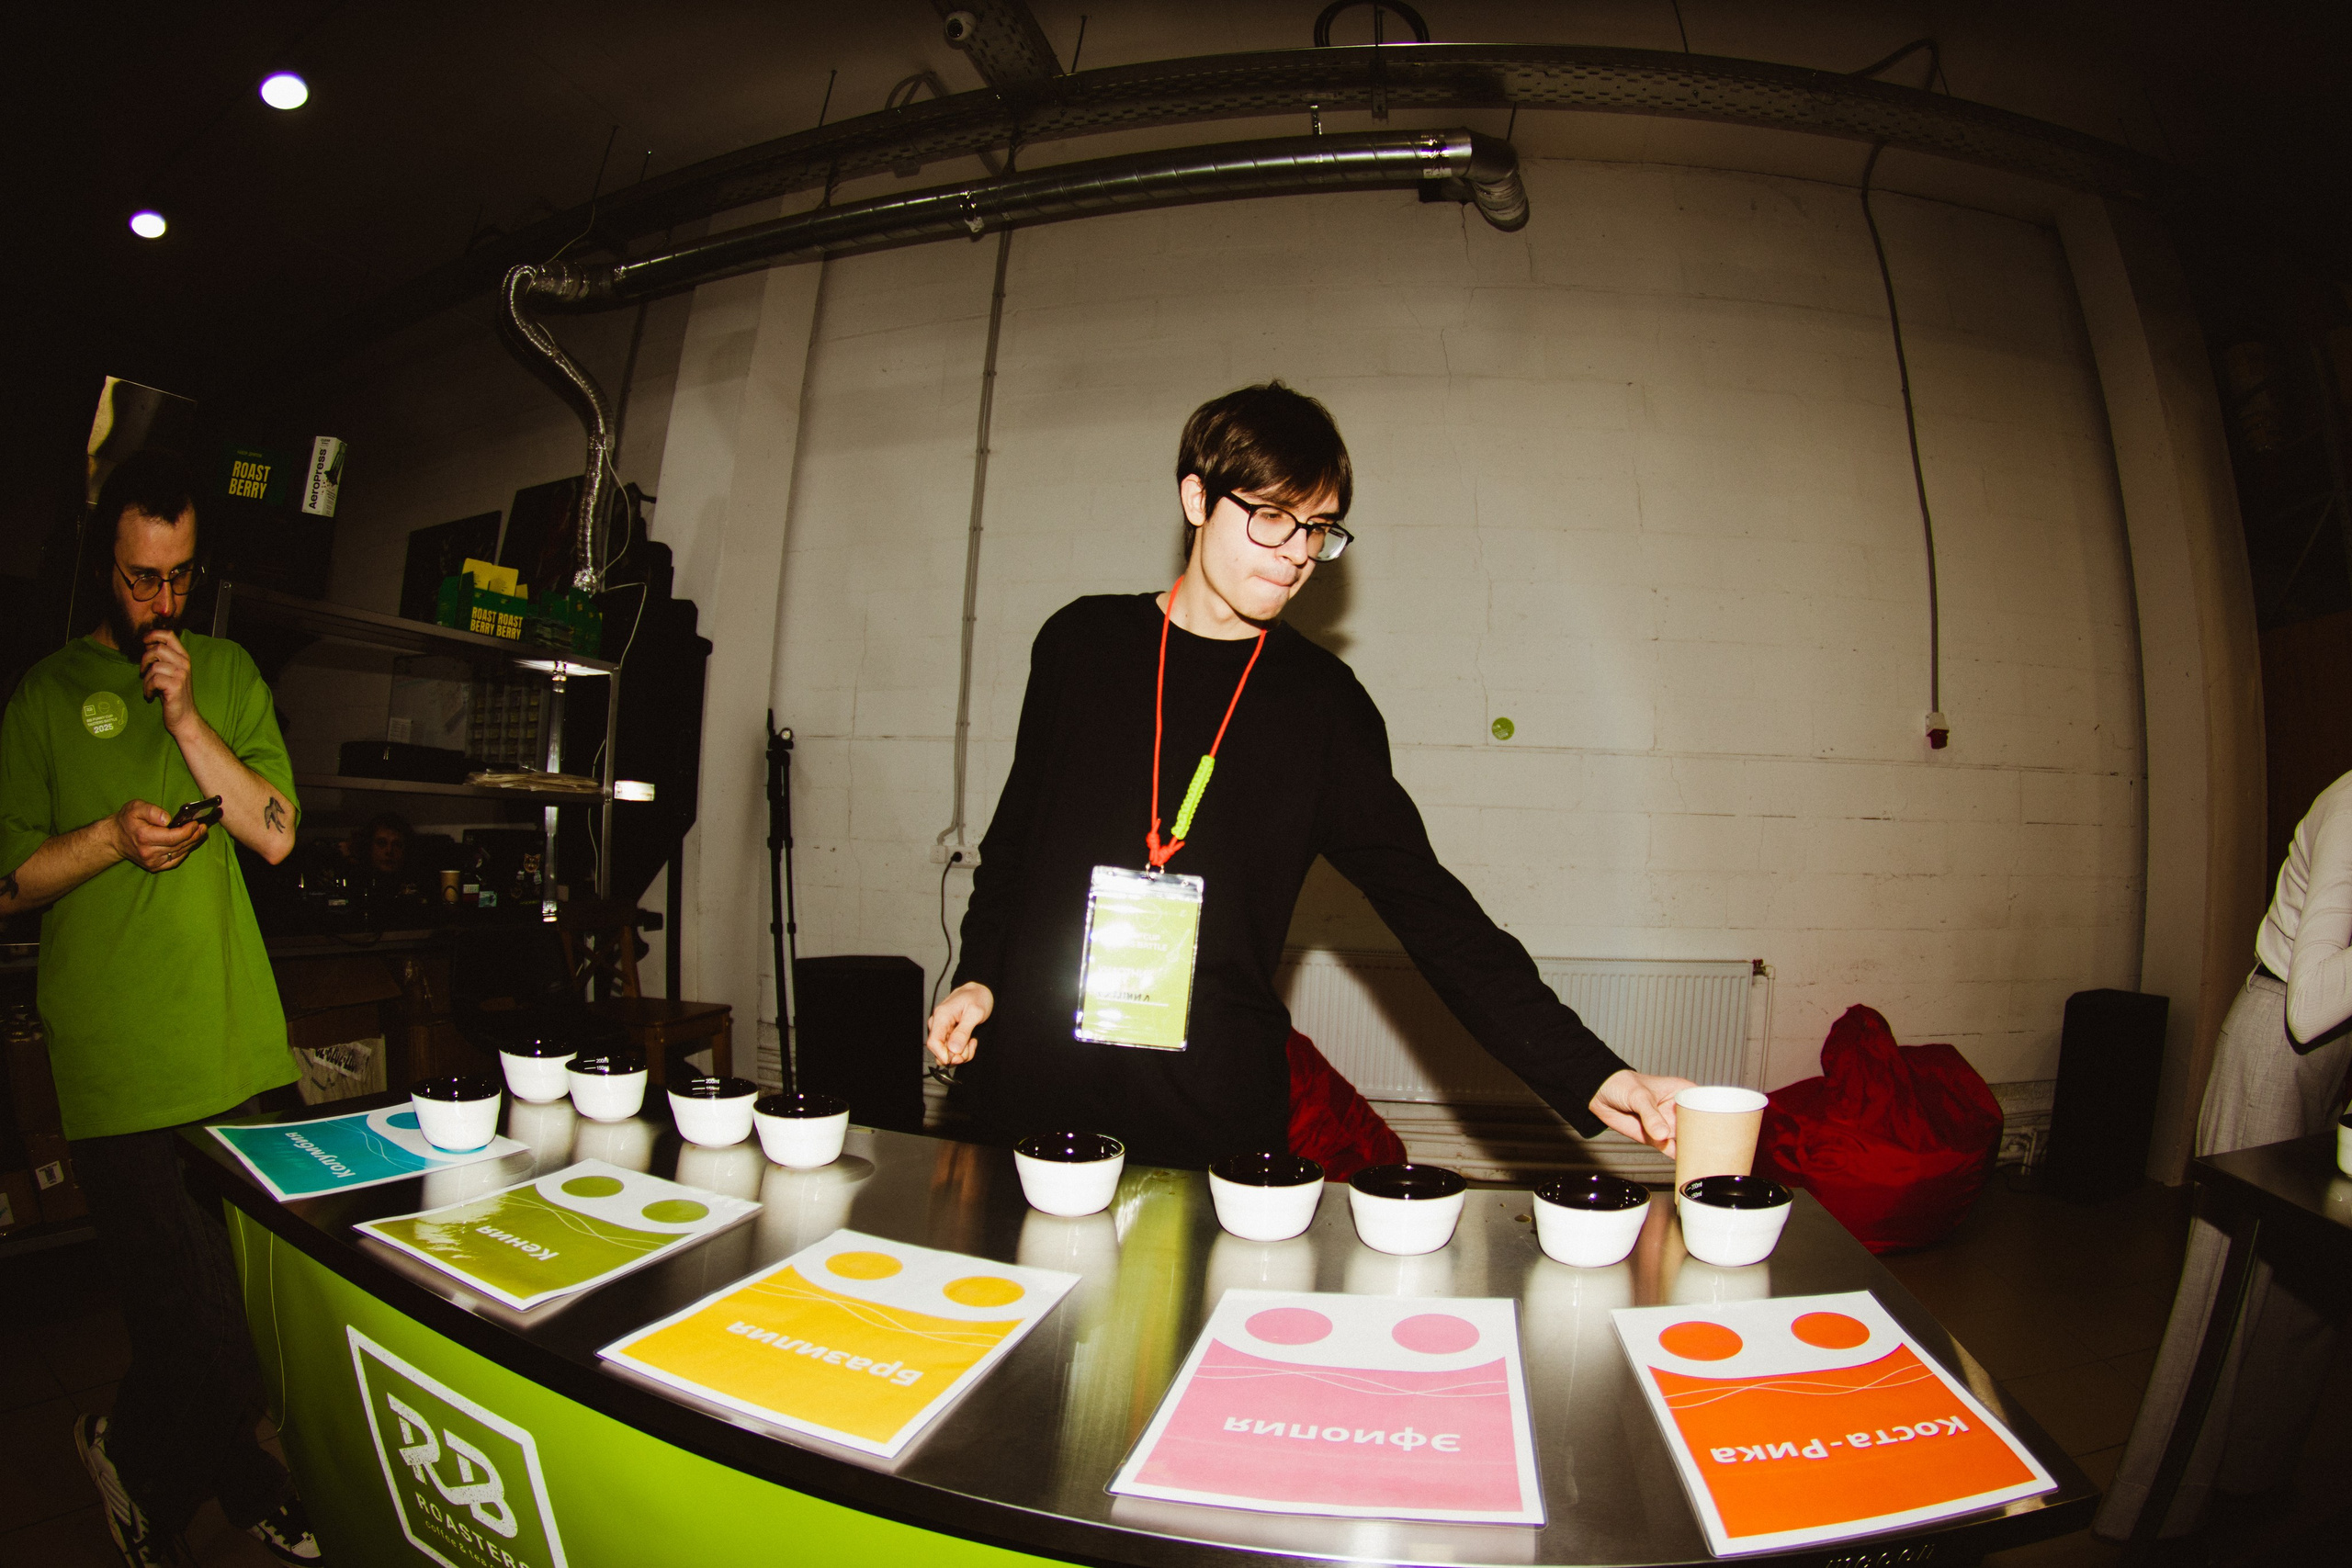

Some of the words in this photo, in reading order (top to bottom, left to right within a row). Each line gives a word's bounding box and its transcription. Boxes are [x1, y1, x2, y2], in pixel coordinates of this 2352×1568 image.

[232, 460, 271, 482] ROAST
[309, 448, 327, 509] AeroPress
[228, 478, 267, 500] BERRY
[472, 606, 498, 623] ROAST
[497, 612, 524, 628] ROAST
[469, 618, 495, 636] BERRY
[496, 625, 522, 641] BERRY
[94, 723, 114, 734] 2025
[1138, 941, 1168, 952] BATTLE
[285, 1132, 356, 1179] Колумбия
[476, 1225, 560, 1261] Кения
[726, 1320, 923, 1387] Бразилия
[1223, 1416, 1462, 1452] Эфиопия
[1711, 1415, 1969, 1464] Коста-Рика
[425, 1520, 457, 1548] coffee
[469, 1549, 488, 1567] tea
